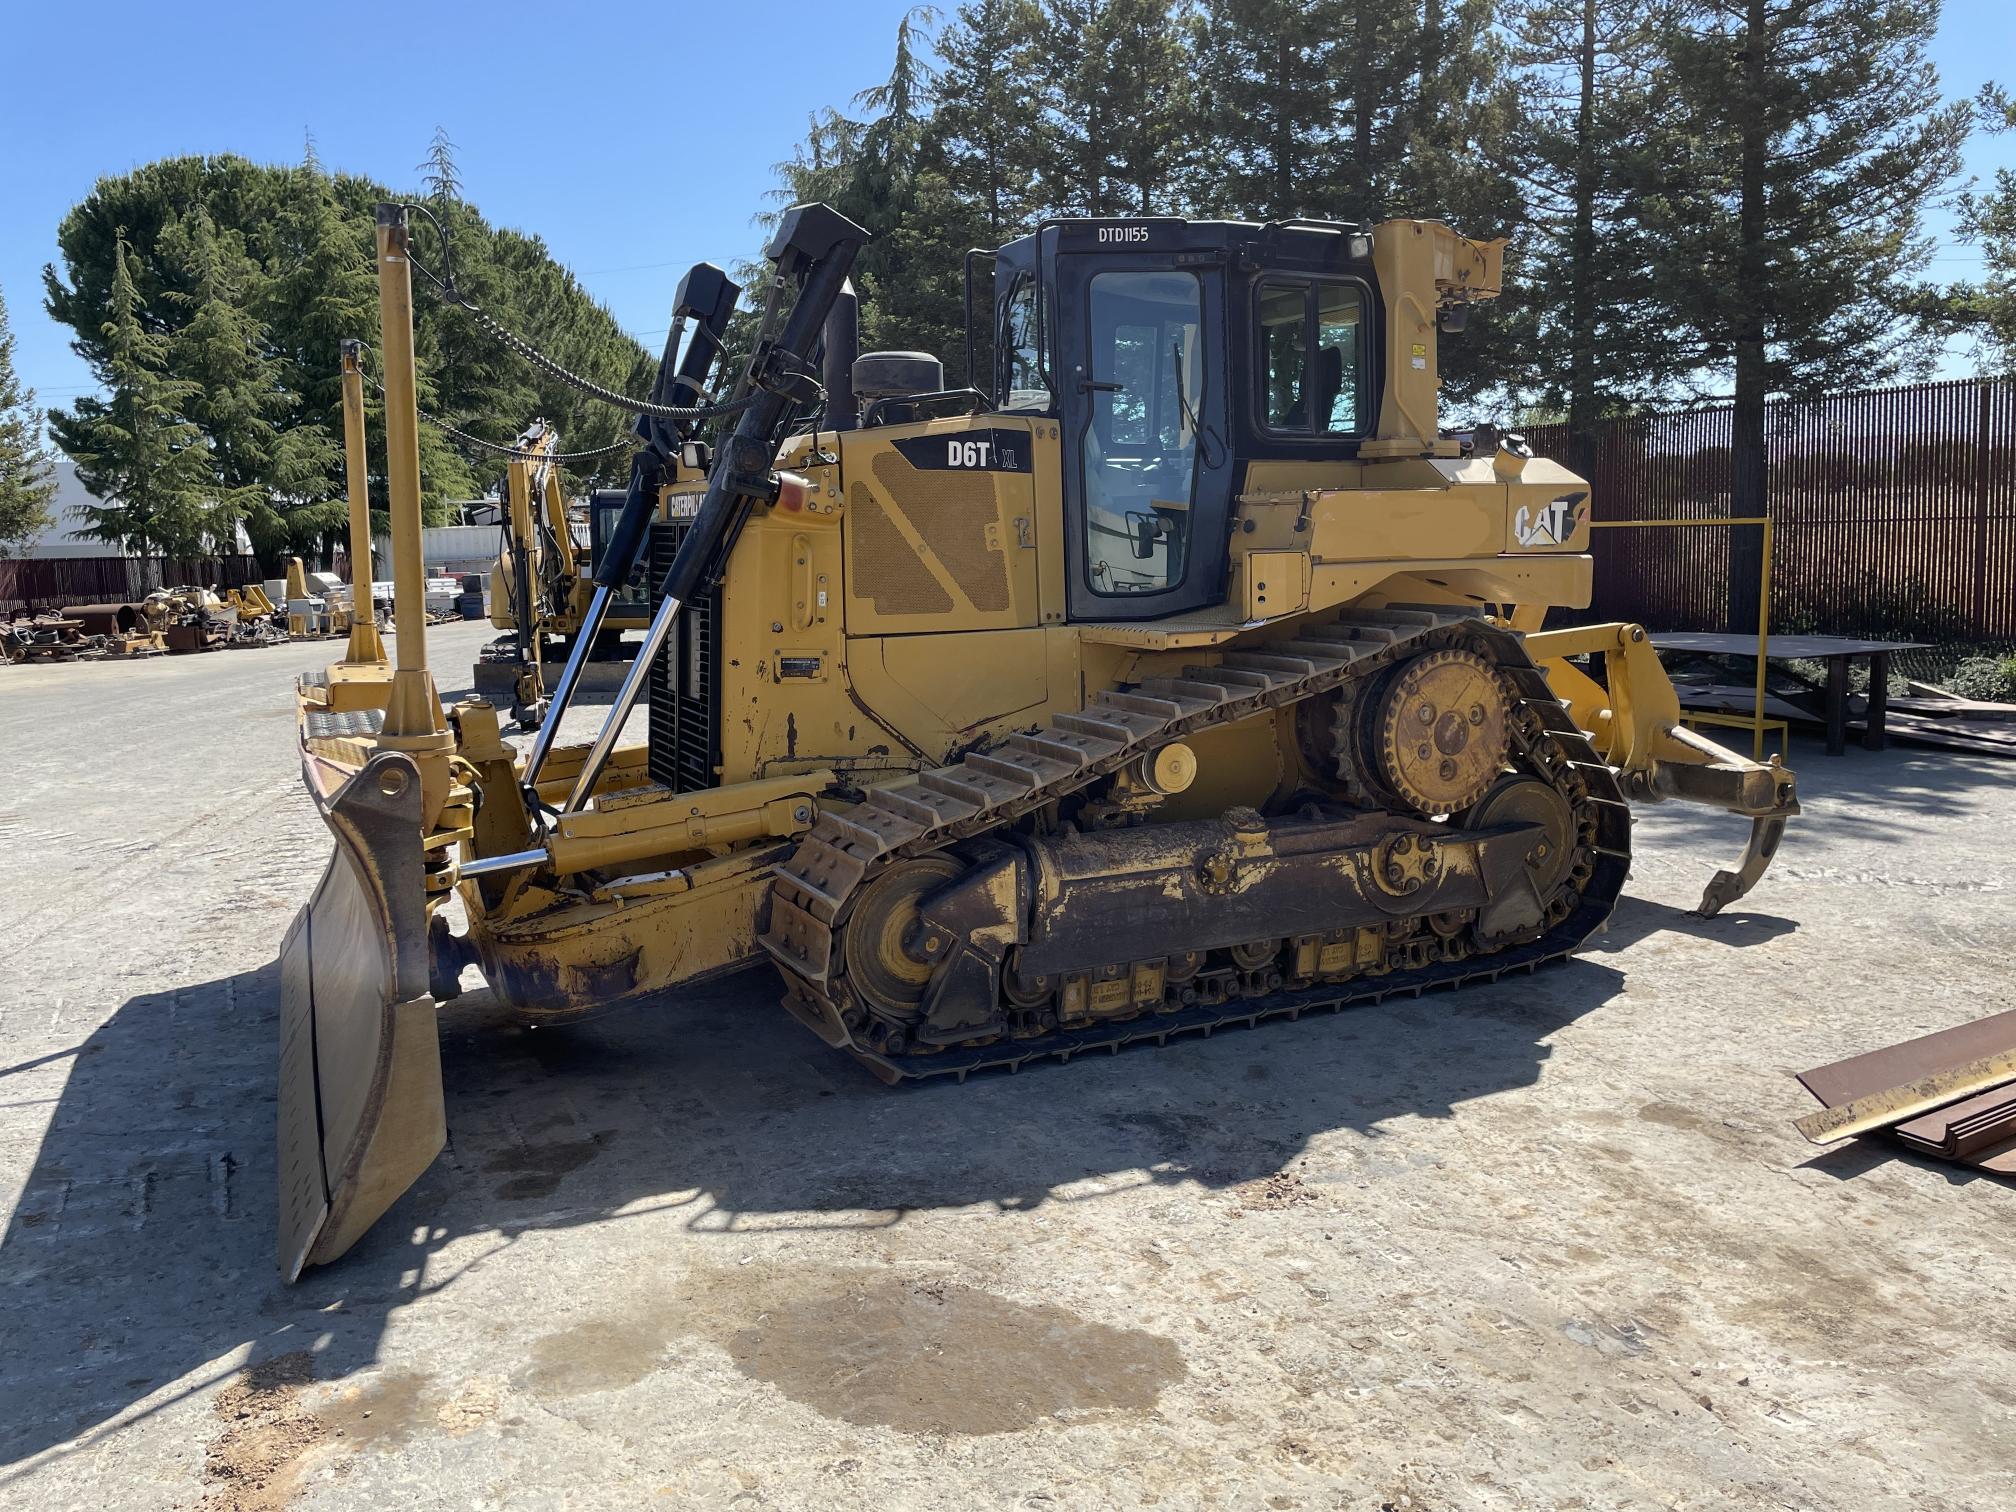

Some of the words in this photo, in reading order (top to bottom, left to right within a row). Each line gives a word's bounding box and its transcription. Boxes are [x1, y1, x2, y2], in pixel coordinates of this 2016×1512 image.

[1098, 226, 1148, 242] DTD1155
[948, 440, 990, 467] D6T
[1002, 449, 1018, 469] XL
[1514, 501, 1568, 545] CAT
